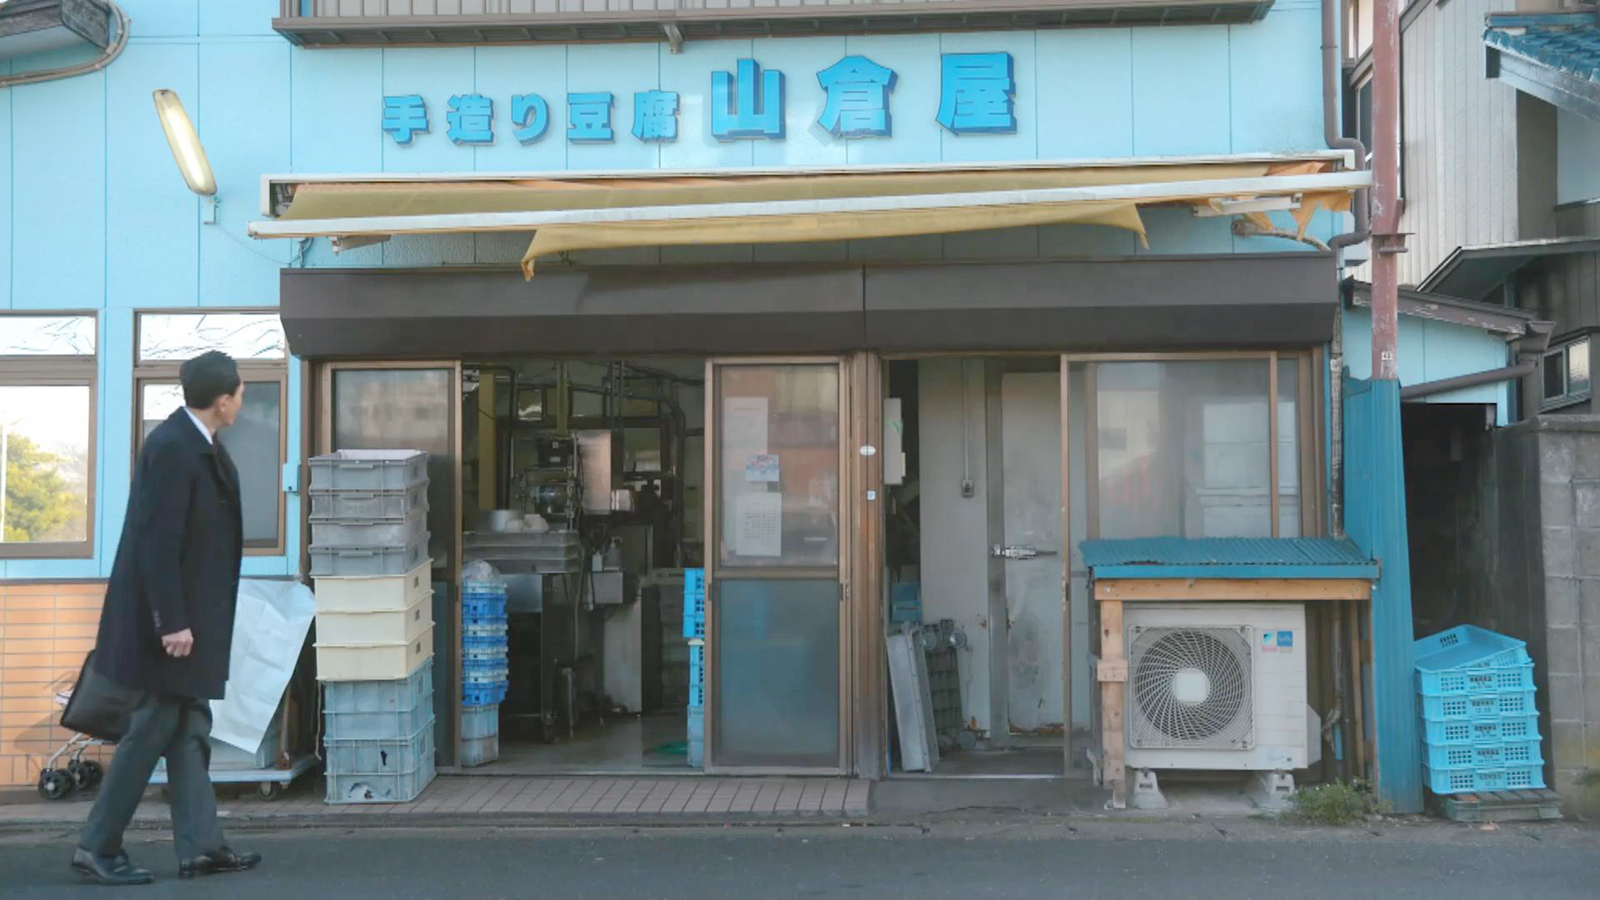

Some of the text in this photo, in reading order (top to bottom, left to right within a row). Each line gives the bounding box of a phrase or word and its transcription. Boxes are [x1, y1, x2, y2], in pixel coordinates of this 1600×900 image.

[382, 52, 1016, 145] 手造り豆腐 山倉屋
